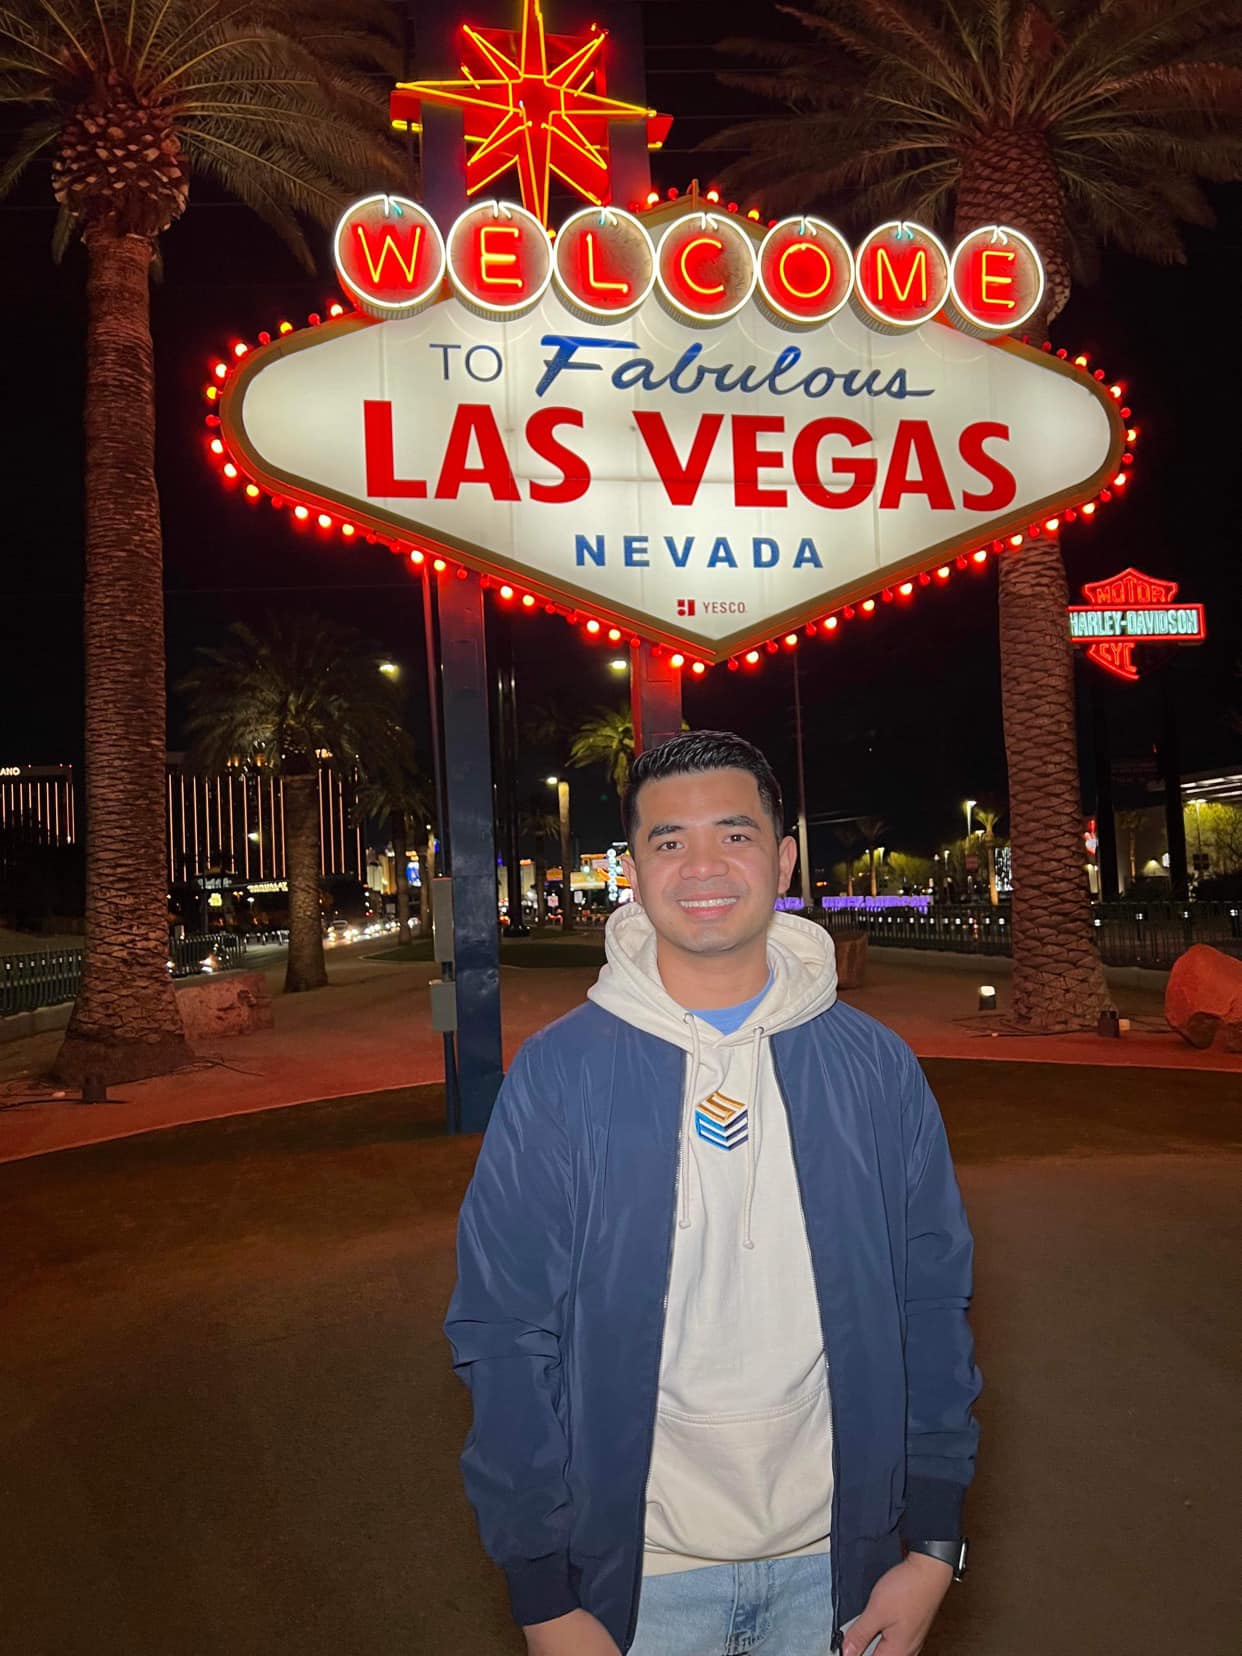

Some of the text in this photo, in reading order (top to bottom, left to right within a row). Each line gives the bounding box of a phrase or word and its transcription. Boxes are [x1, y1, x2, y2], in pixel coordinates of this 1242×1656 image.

[356, 226, 1017, 309] WELCOME
[429, 335, 935, 398] TO Fabulous
[363, 400, 1017, 512] LAS VEGAS
[574, 534, 823, 569] NEVADA
[1096, 575, 1166, 603] MOTOR
[703, 601, 746, 614] YESCO
[1069, 609, 1199, 636] HARLEY-DAVIDSON
